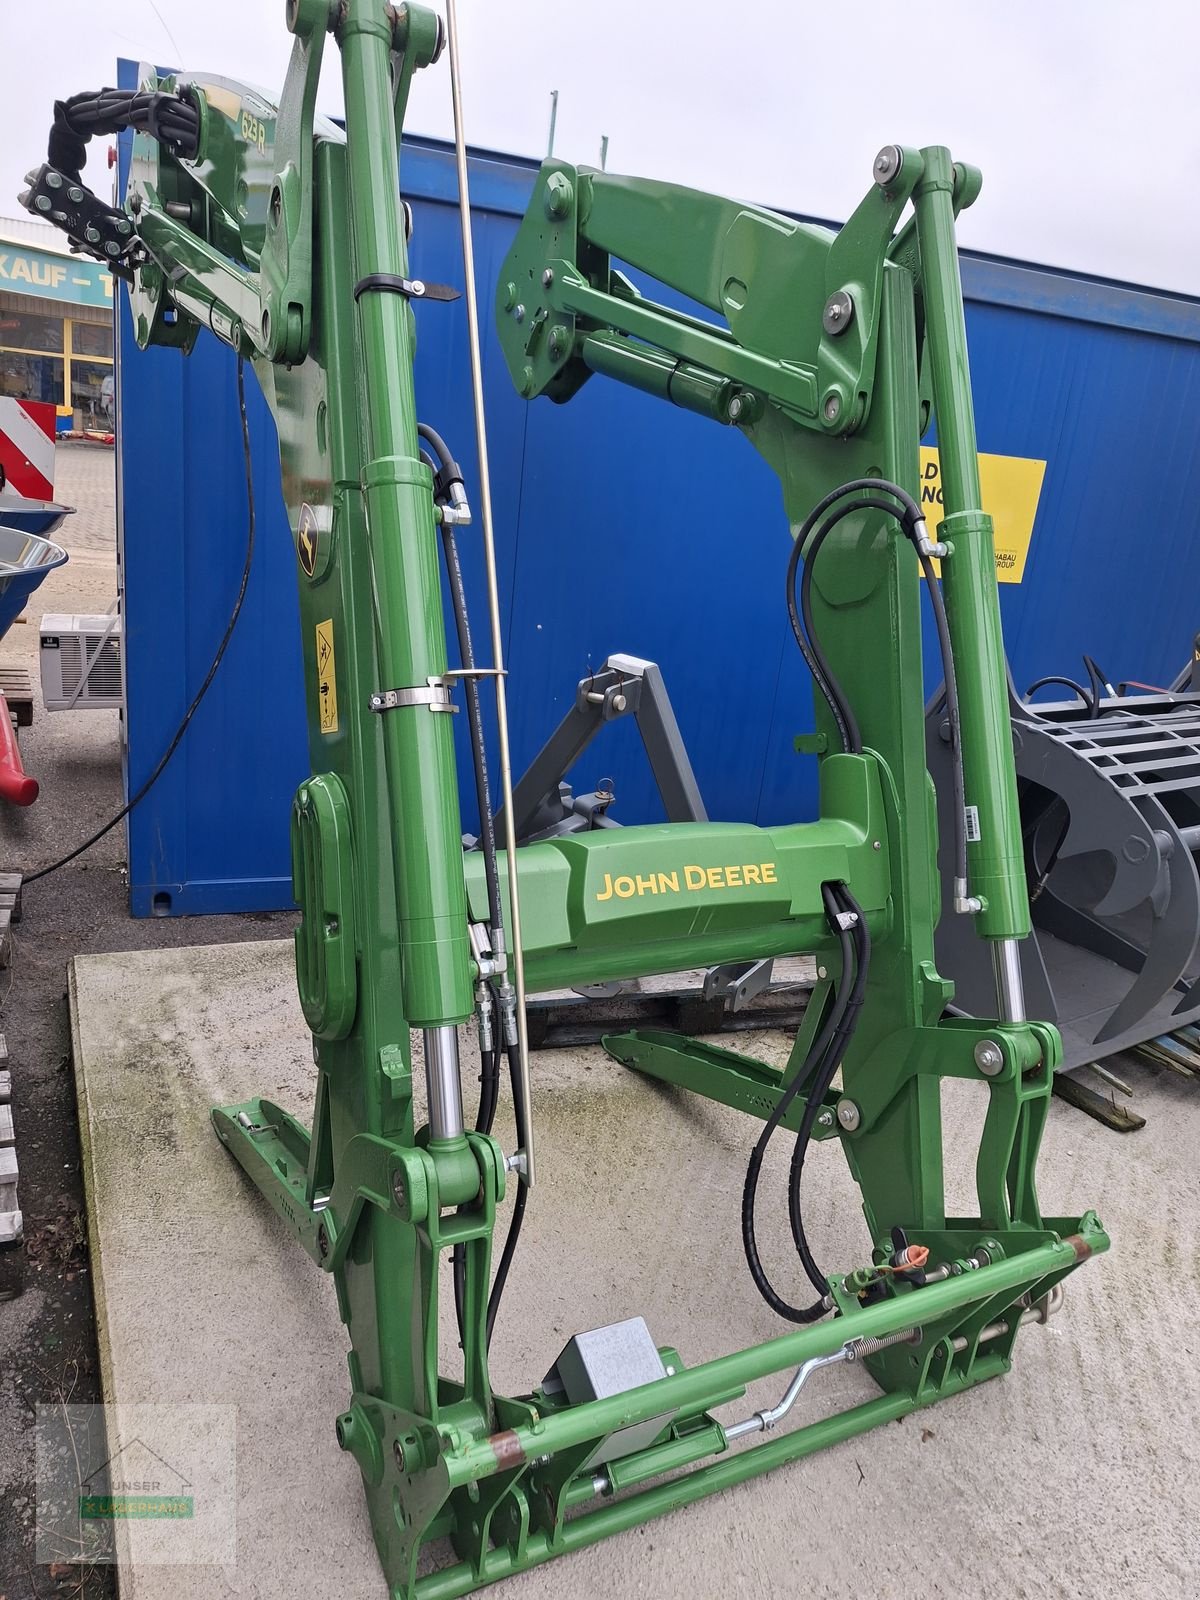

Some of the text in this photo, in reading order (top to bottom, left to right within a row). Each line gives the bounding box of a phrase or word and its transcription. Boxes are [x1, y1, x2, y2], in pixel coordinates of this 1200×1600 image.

[242, 112, 265, 155] 623R
[597, 863, 777, 901] JOHN DEERE
